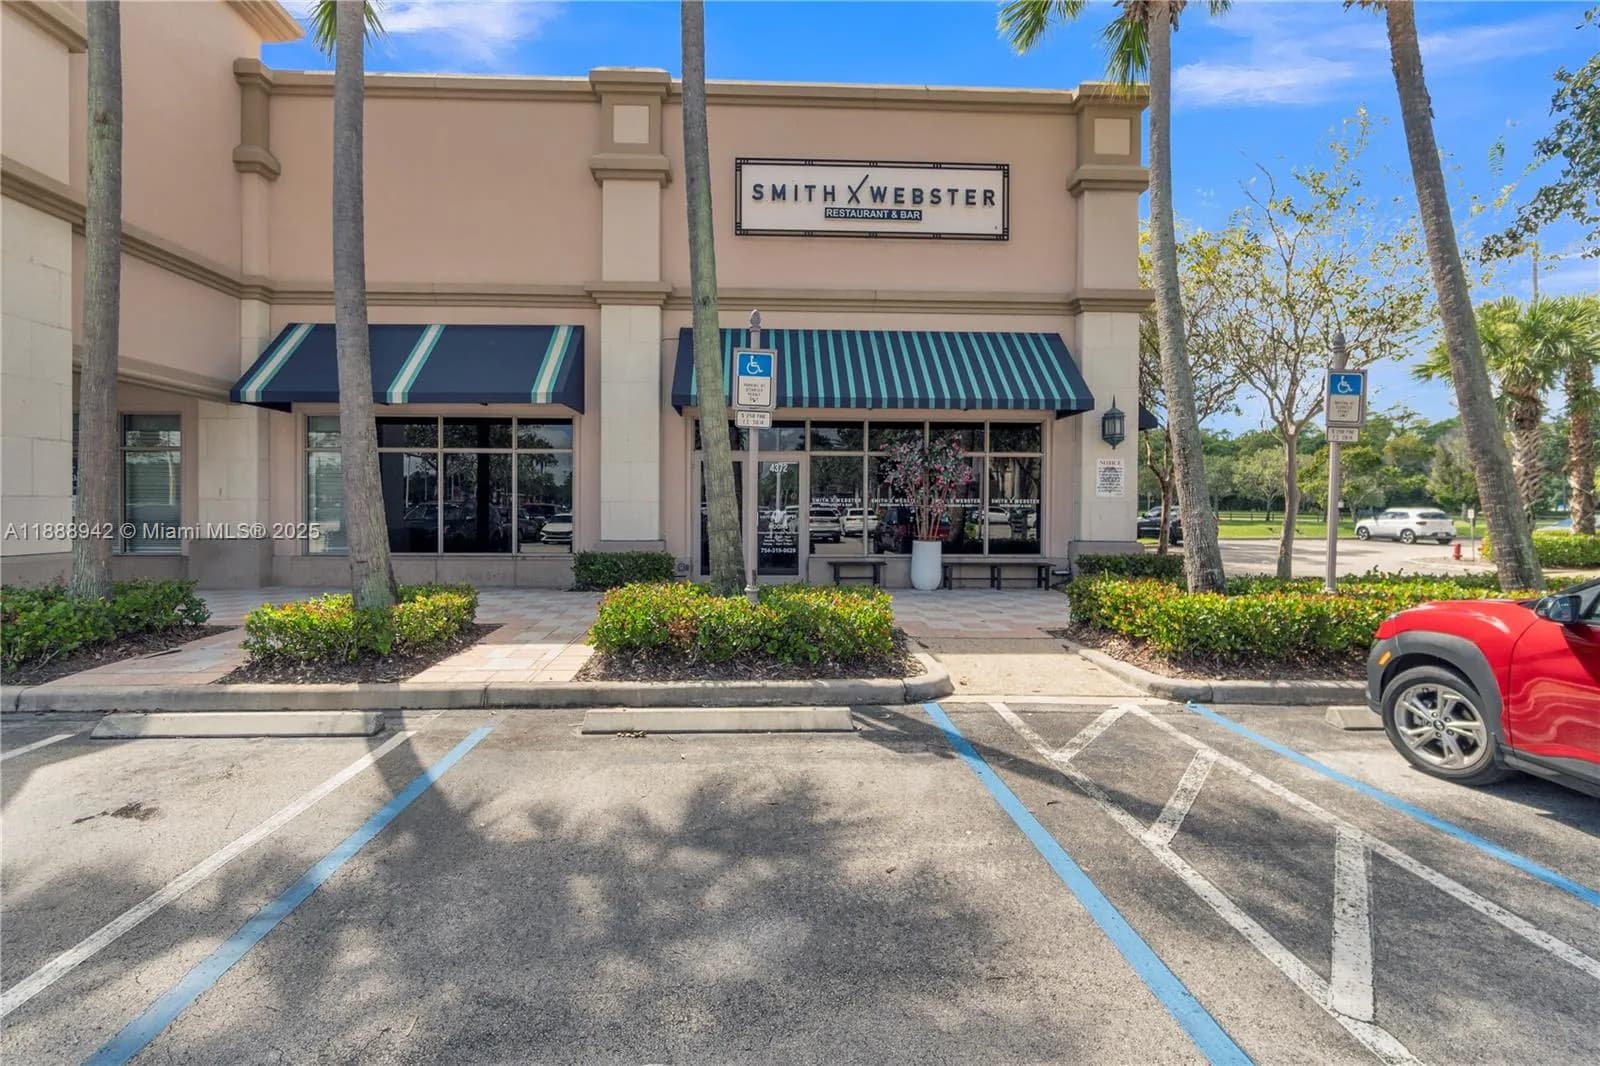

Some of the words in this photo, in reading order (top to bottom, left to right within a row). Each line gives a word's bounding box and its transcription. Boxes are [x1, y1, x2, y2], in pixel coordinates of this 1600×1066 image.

[752, 183, 836, 202] SMITH
[847, 174, 869, 204] X
[870, 186, 996, 206] WEBSTER
[826, 208, 889, 219] RESTAURANT
[890, 210, 899, 219] &
[900, 210, 921, 220] BAR
[769, 463, 788, 472] 4372
